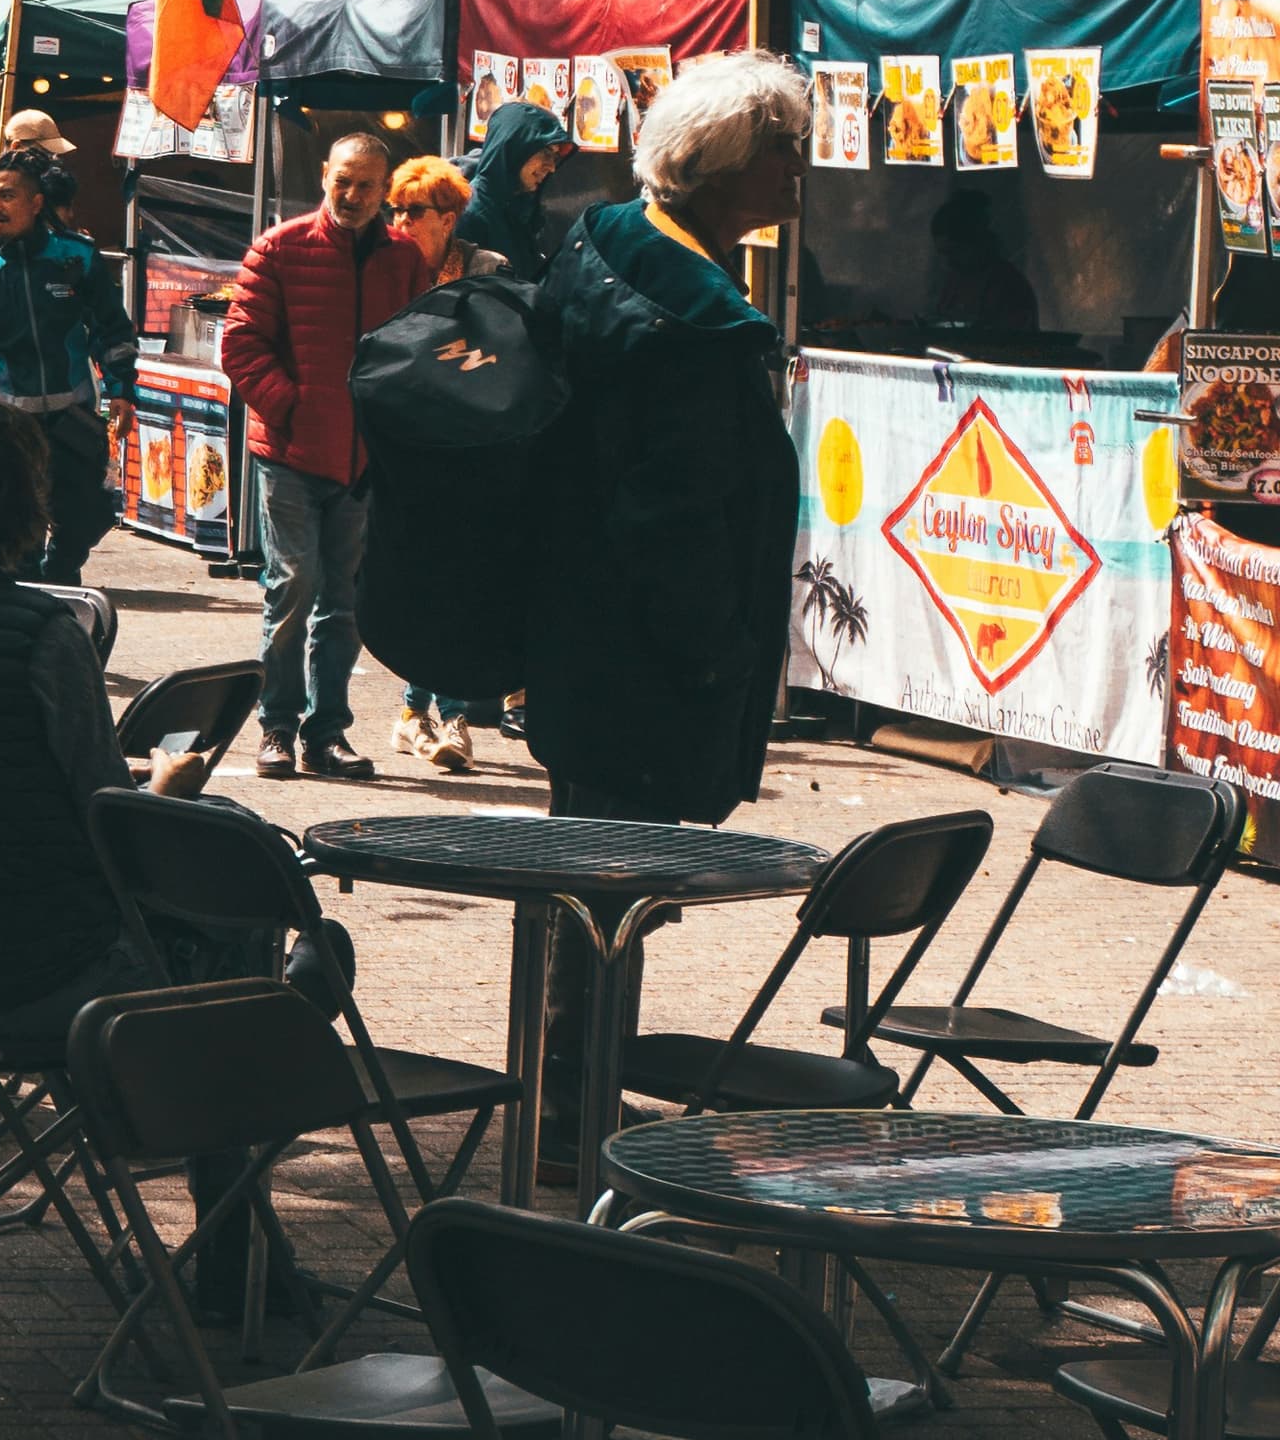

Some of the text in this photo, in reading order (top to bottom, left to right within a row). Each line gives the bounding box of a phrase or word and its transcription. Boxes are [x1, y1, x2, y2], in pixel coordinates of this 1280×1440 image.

[1226, 94, 1252, 112] BOWL
[1216, 116, 1253, 138] LAKSA
[923, 494, 1056, 570] Ceylon Spicy
[986, 691, 1047, 741] Lankan
[1050, 704, 1103, 752] Cuisine
